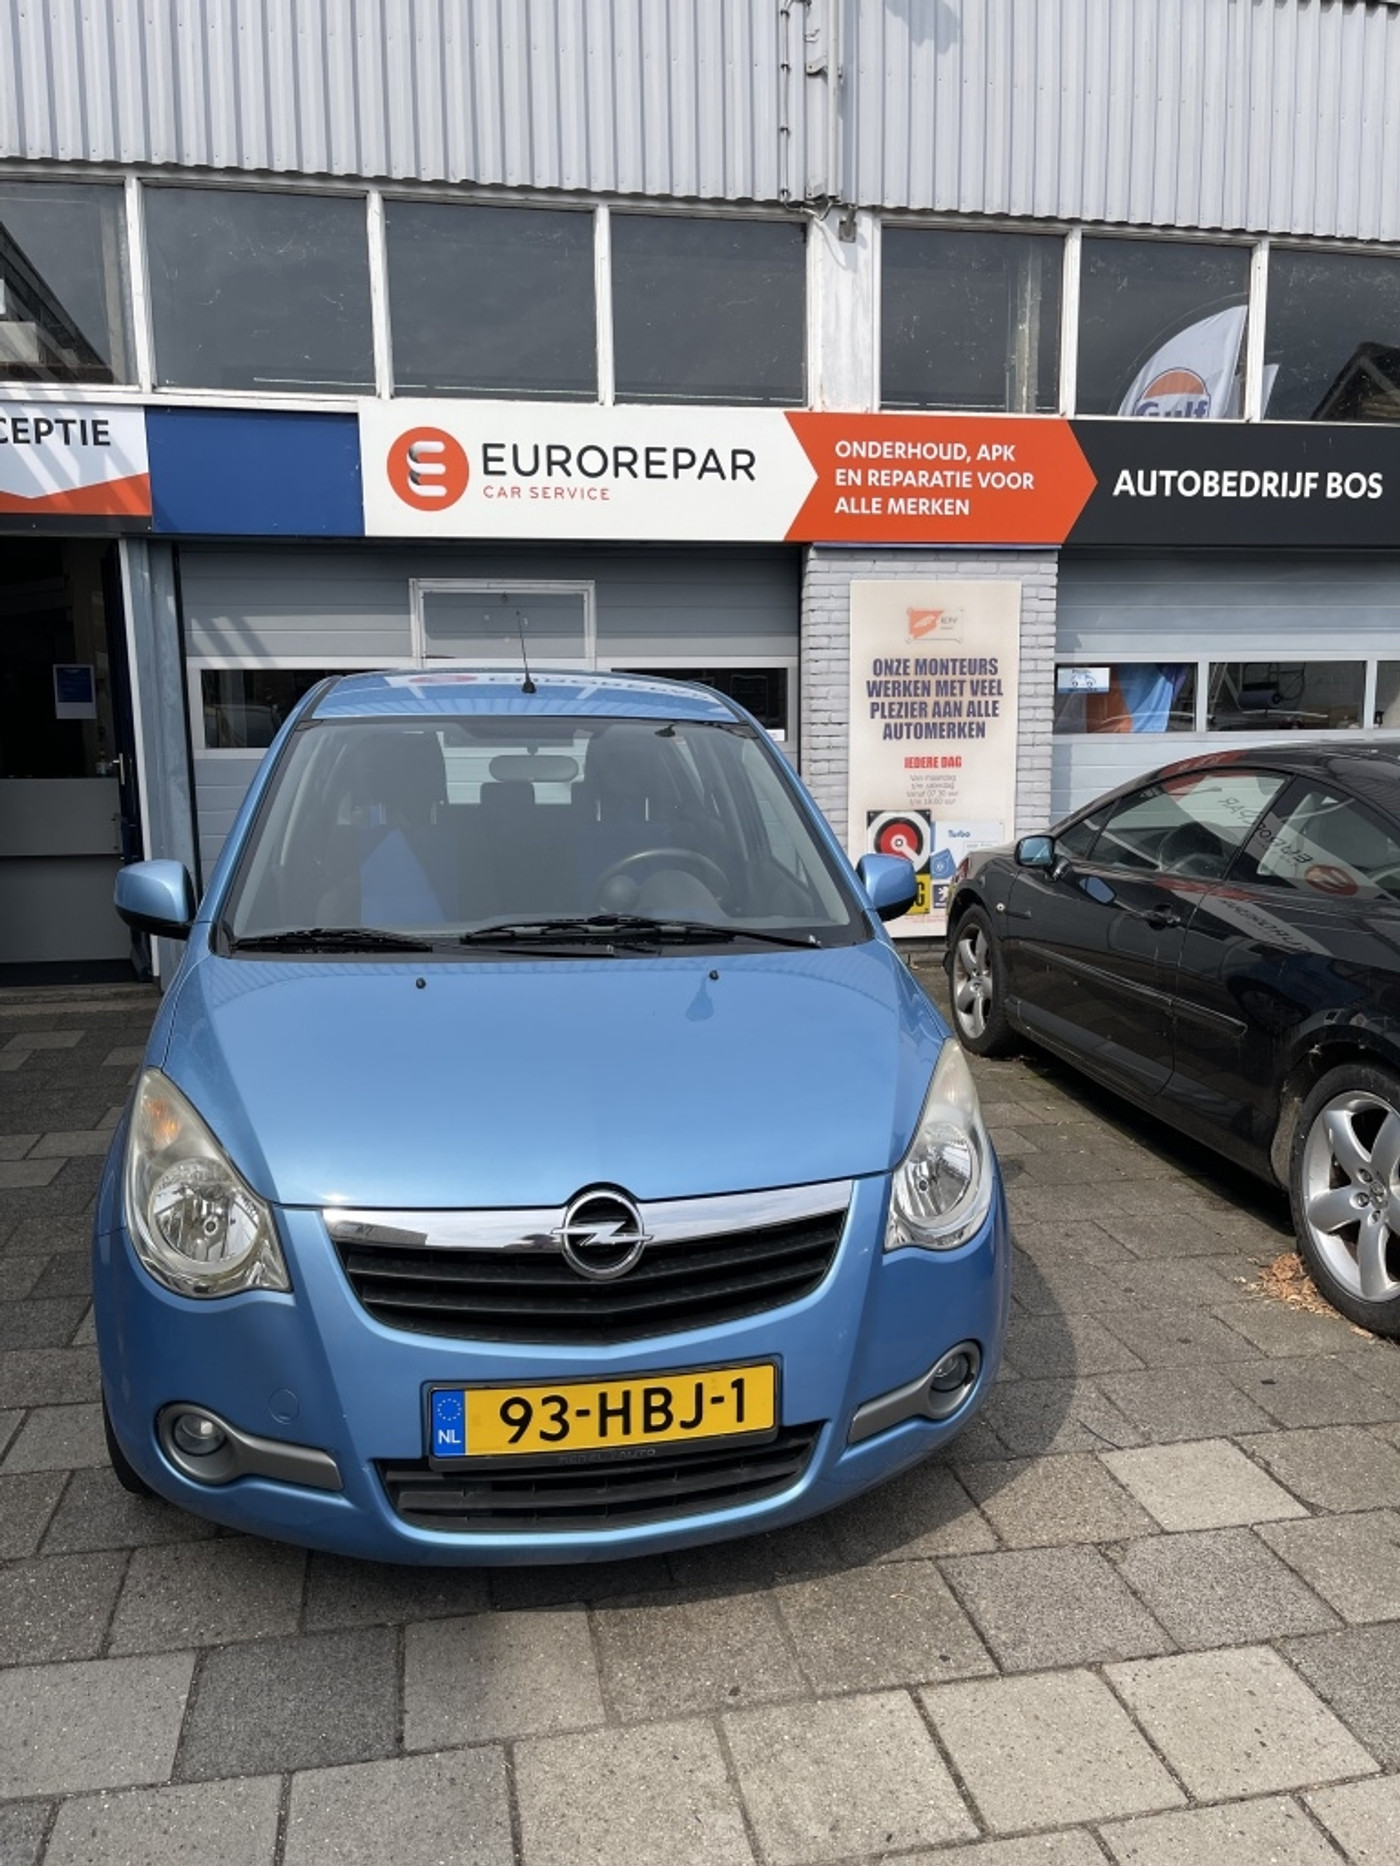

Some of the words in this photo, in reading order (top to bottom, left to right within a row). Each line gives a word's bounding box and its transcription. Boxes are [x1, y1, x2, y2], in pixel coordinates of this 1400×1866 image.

[834, 440, 971, 463] ONDERHOUD,
[976, 444, 1015, 461] APK
[482, 443, 756, 481] EUROREPAR
[834, 468, 862, 486] EN
[866, 469, 972, 488] REPARATIE
[977, 471, 1034, 489] VOOR
[1112, 469, 1319, 499] AUTOBEDRIJF
[1326, 472, 1383, 499] BOS
[483, 485, 521, 499] CAR
[530, 487, 610, 500] SERVICE
[834, 497, 882, 514] ALLE
[887, 498, 970, 515] MERKEN
[873, 658, 910, 676] ONZE
[914, 658, 999, 675] MONTEURS
[866, 680, 931, 698] WERKEN
[935, 680, 966, 697] MET
[970, 679, 1004, 697] VEEL
[870, 701, 928, 719] PLEZIER
[932, 701, 962, 718] AAN
[966, 700, 1000, 718] ALLE
[882, 721, 986, 740] AUTOMERKEN
[904, 756, 939, 769] IEDERE
[941, 756, 962, 768] DAG
[948, 829, 971, 838] Turbo
[499, 1377, 745, 1443] 93-HBJ-1
[438, 1429, 460, 1444] NL
